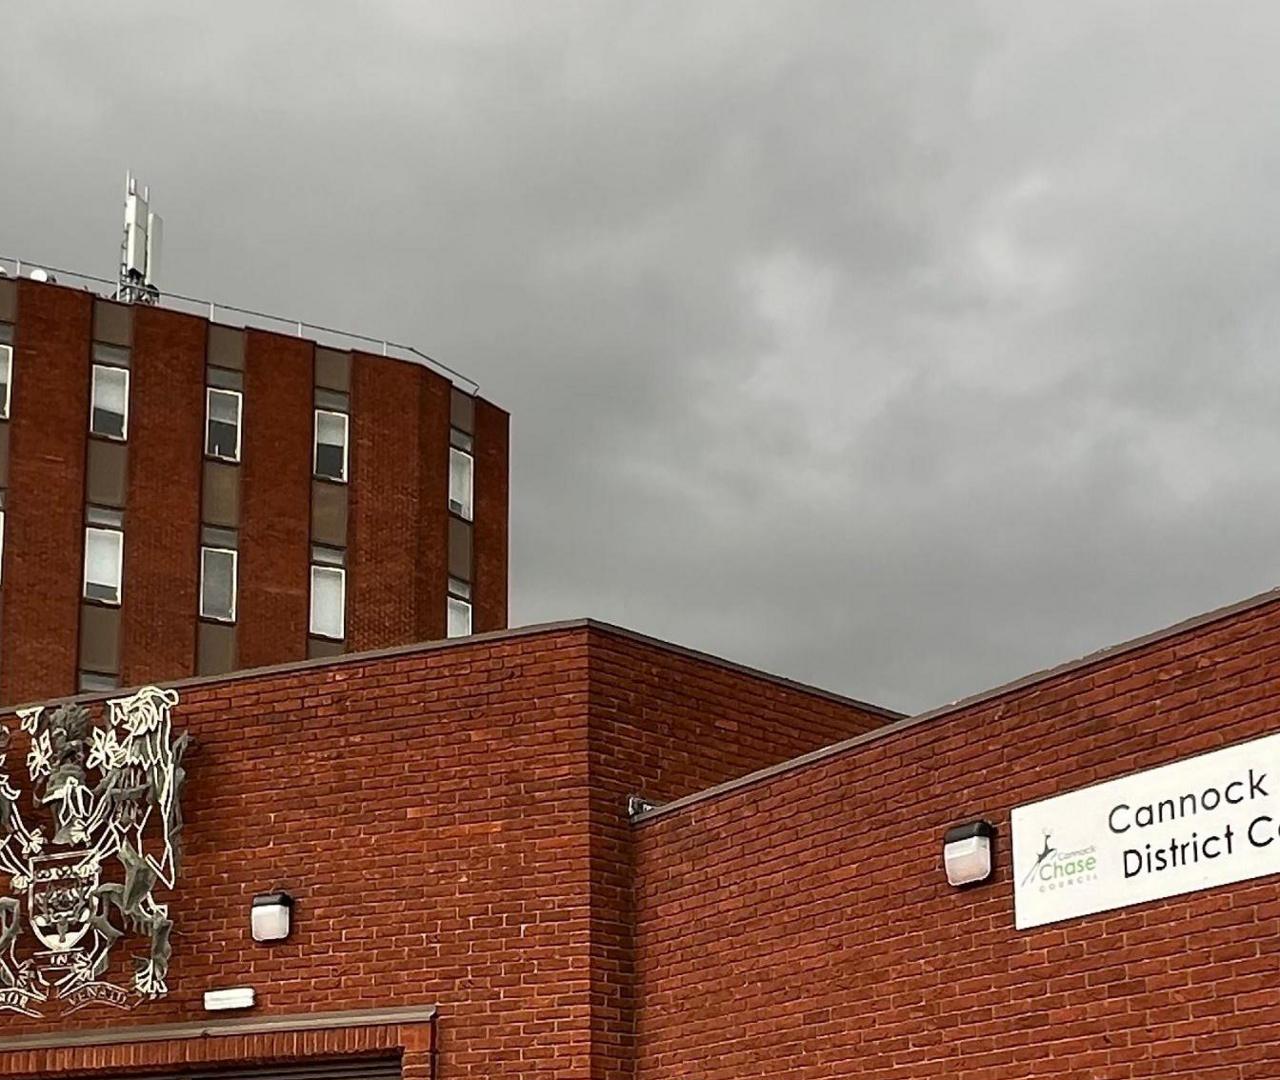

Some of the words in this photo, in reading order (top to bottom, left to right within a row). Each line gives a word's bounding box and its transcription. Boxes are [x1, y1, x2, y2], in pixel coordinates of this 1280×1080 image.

[1108, 769, 1269, 833] Cannock
[1040, 856, 1096, 881] Chase
[1123, 825, 1233, 878] District
[50, 955, 67, 965] IN
